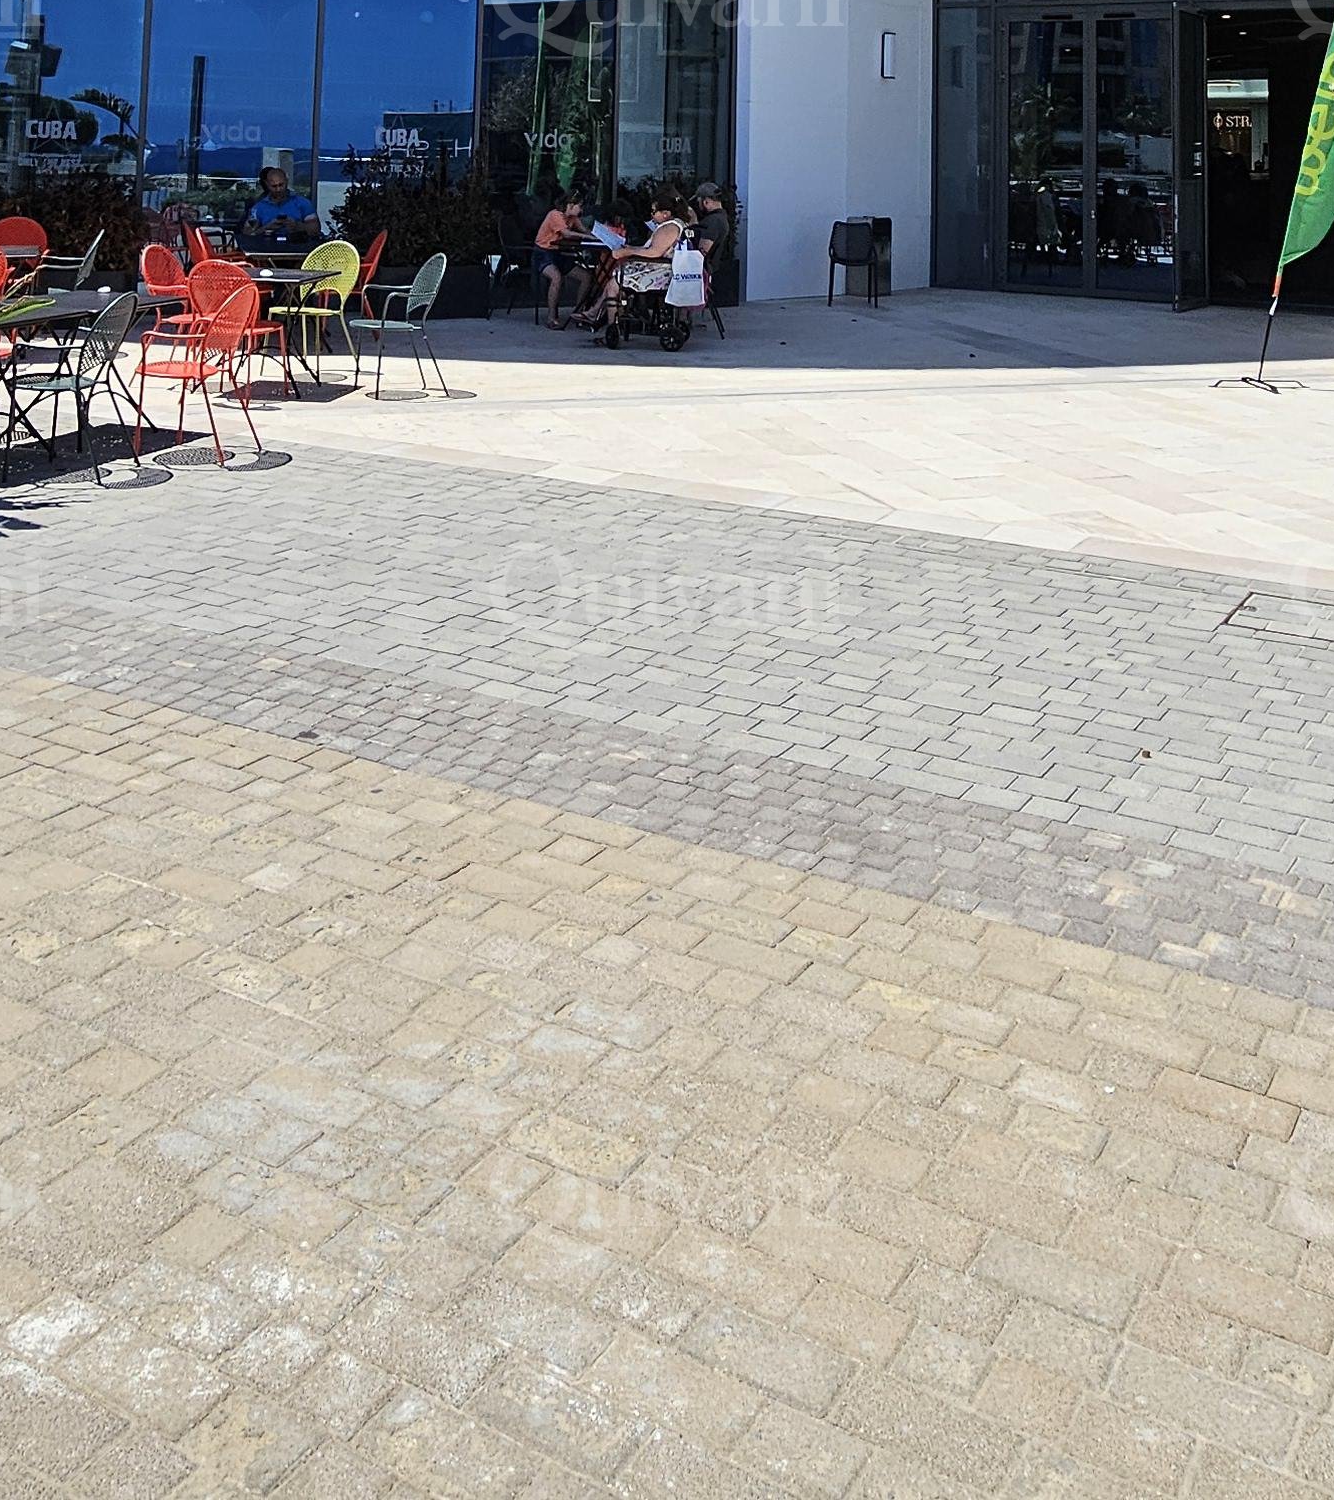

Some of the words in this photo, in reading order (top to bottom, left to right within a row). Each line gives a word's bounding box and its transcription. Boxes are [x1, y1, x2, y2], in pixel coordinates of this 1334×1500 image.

[25, 119, 77, 140] CUBA
[1225, 115, 1253, 128] STR
[375, 127, 420, 148] CUBA
[524, 128, 571, 149] vida
